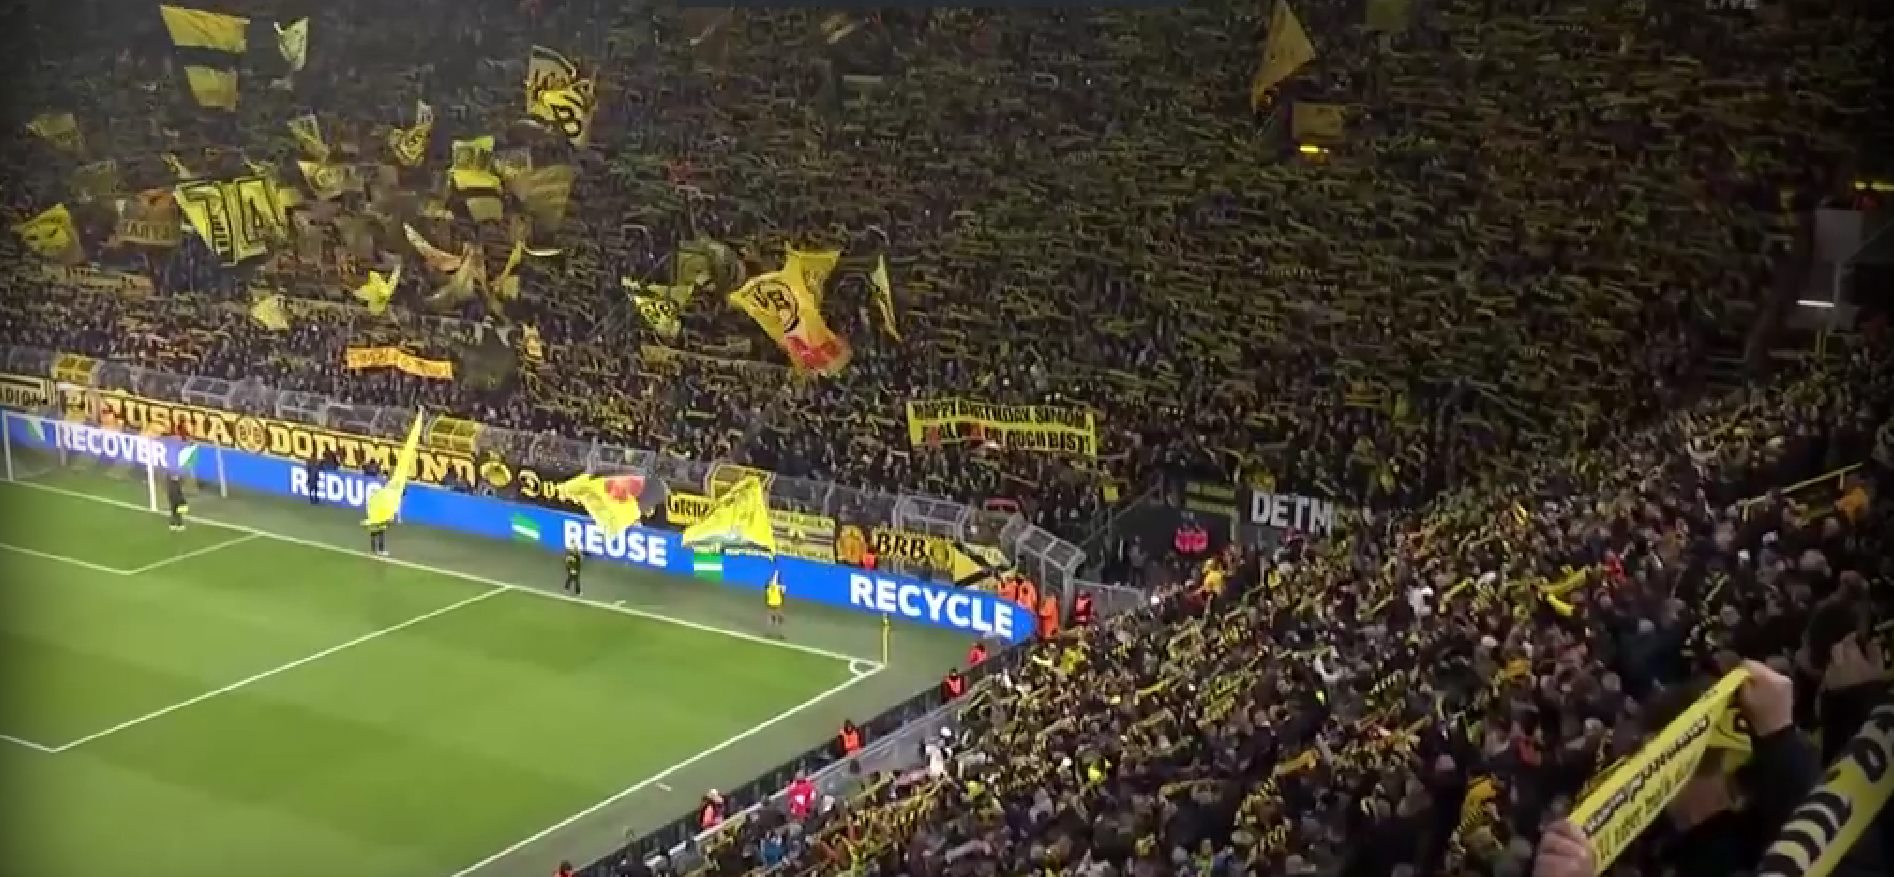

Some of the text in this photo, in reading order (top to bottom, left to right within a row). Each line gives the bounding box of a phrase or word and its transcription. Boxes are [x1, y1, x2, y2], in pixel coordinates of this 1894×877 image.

[55, 421, 168, 467] RECOVER
[271, 425, 476, 486] DORTMND
[1251, 489, 1333, 537] DETM
[564, 519, 668, 568] REUSE
[850, 572, 1014, 643] RECYCLE
